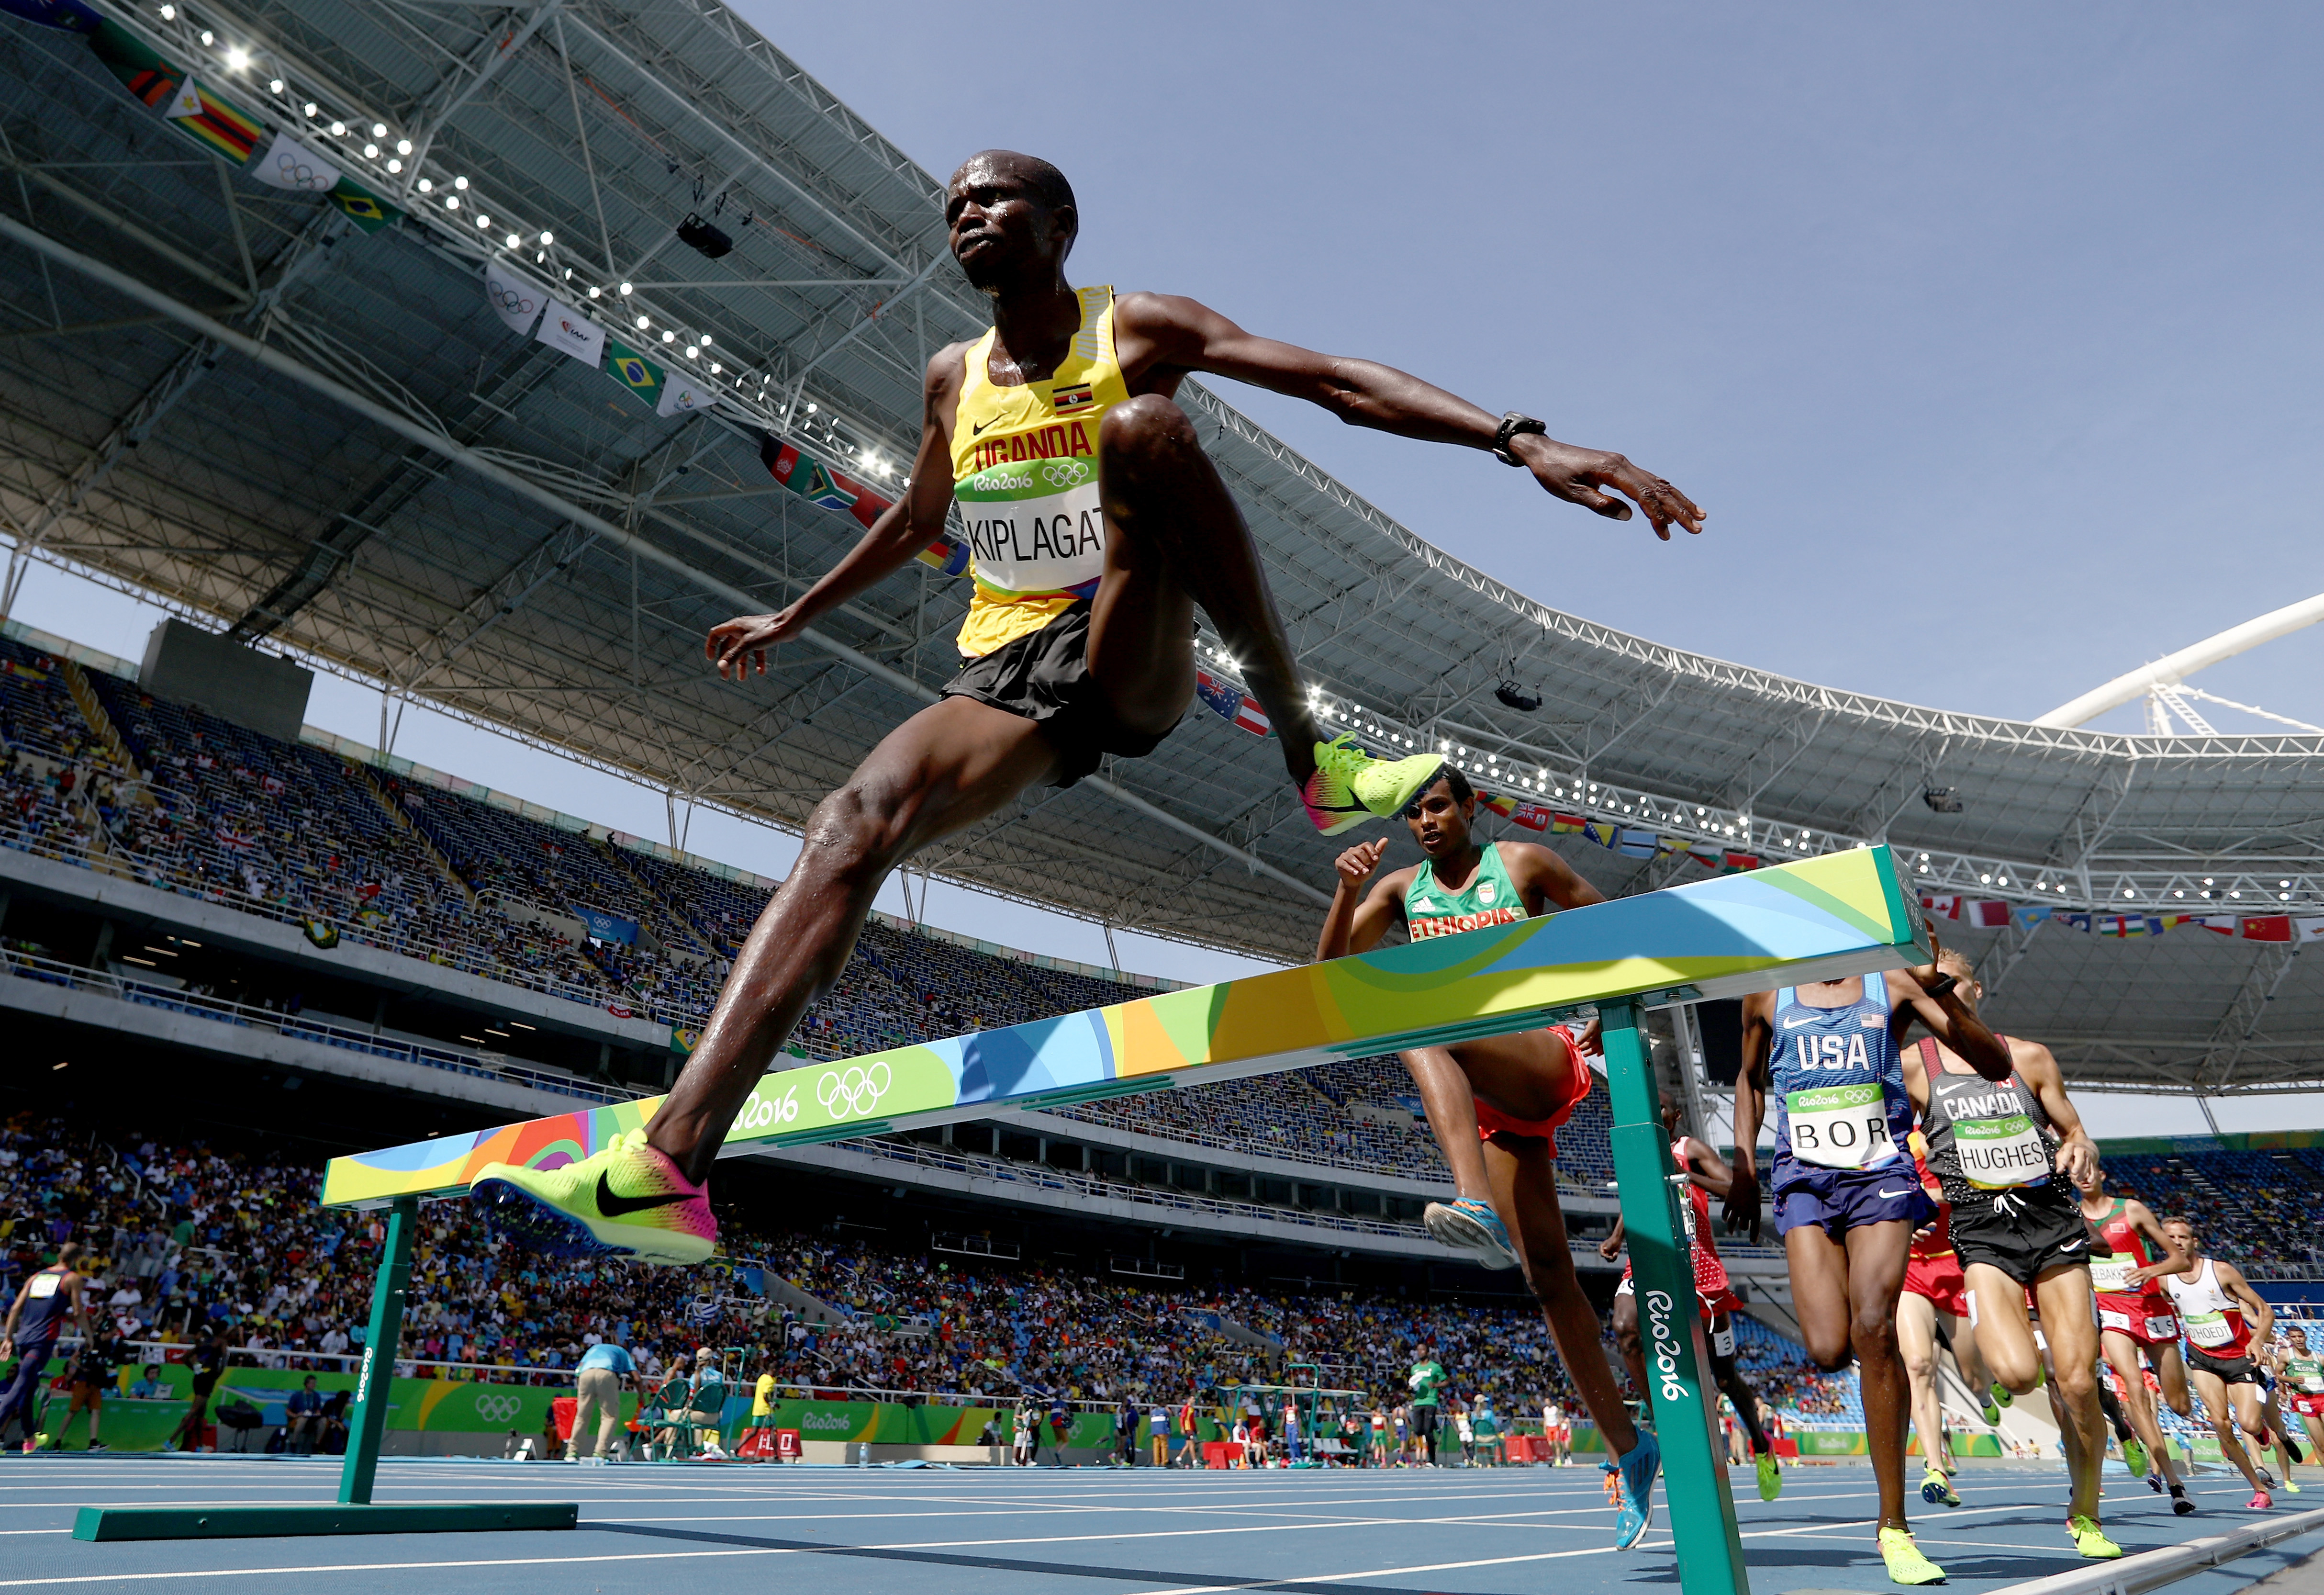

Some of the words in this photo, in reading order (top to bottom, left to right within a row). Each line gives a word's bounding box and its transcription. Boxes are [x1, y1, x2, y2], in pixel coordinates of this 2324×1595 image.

[975, 421, 1093, 471] UGANDA
[973, 472, 1034, 492] Rio2016
[1409, 907, 1516, 939] ETHIOPIA
[1796, 1033, 1870, 1071] USA
[730, 1084, 799, 1132] o2016
[1798, 1093, 1839, 1108] Rio2016
[1943, 1092, 2026, 1121] CANADA
[1795, 1118, 1888, 1148] BOR
[1965, 1125, 2001, 1135] Rio2016
[1961, 1142, 2044, 1169] HUGHES
[2091, 1268, 2124, 1280] ELBAKK
[1645, 1290, 1689, 1401] Rio2016
[1723, 1336, 1732, 1350] 3
[2189, 1325, 2230, 1339] D'HOEDT
[357, 1347, 373, 1402] Rio2016
[802, 1412, 850, 1430] Rio2016
